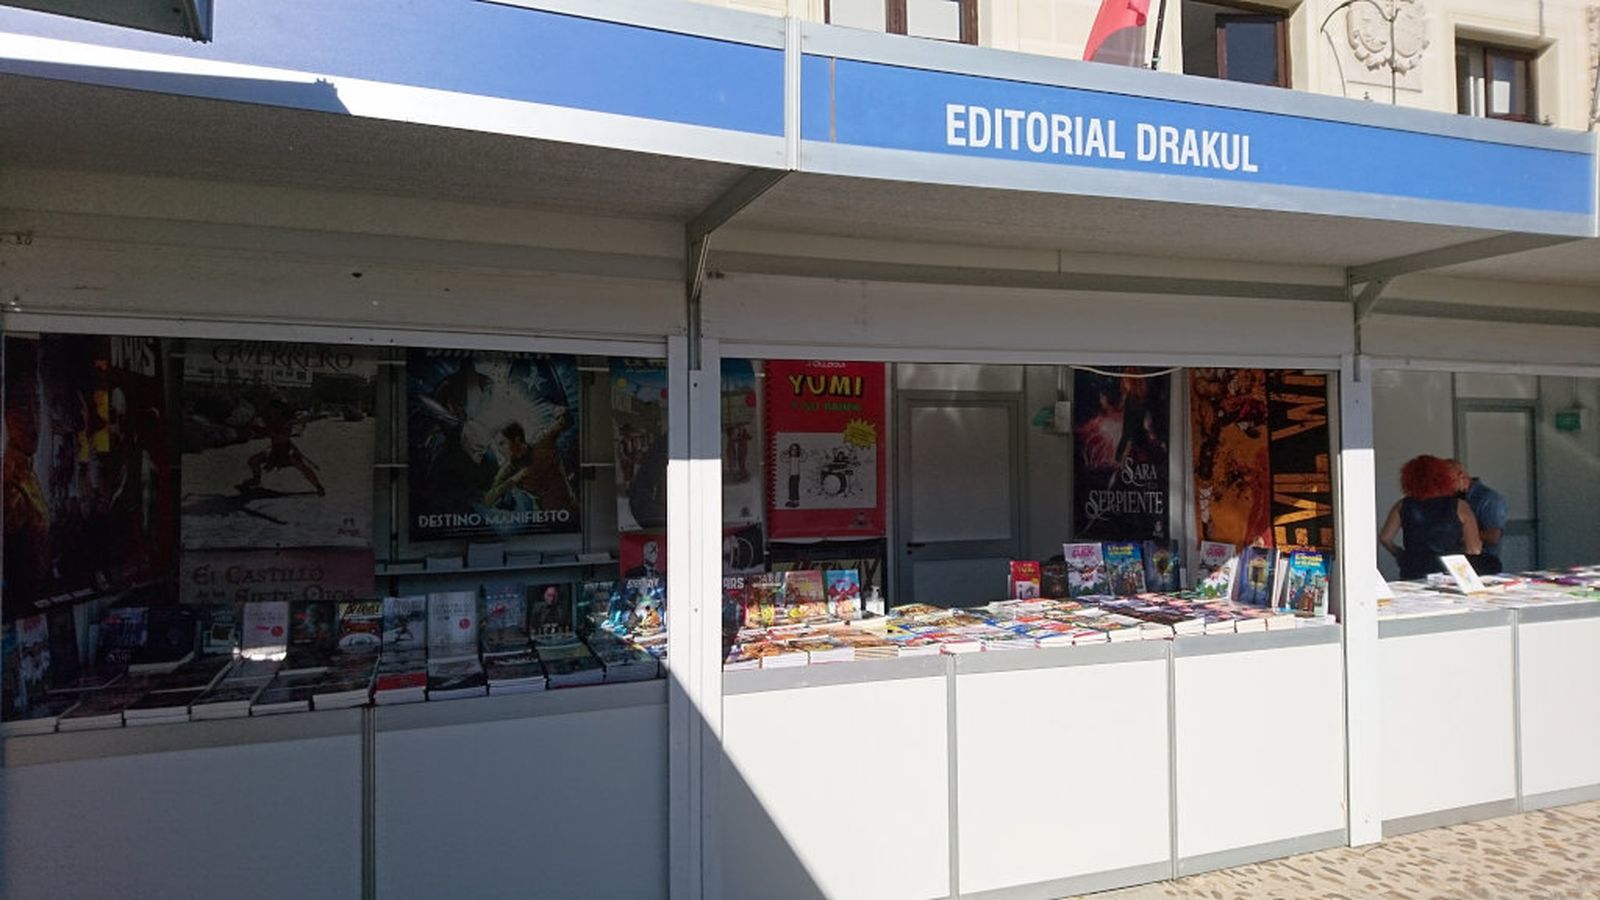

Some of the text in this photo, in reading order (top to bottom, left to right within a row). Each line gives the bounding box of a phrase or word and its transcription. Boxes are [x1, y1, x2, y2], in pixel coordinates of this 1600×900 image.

[946, 104, 1258, 173] EDITORIAL DRAKUL
[788, 374, 863, 398] YUMI
[1121, 457, 1158, 487] SARA
[418, 510, 570, 528] DESTINO MANIFIESTO
[1085, 490, 1163, 521] SERPIENTE
